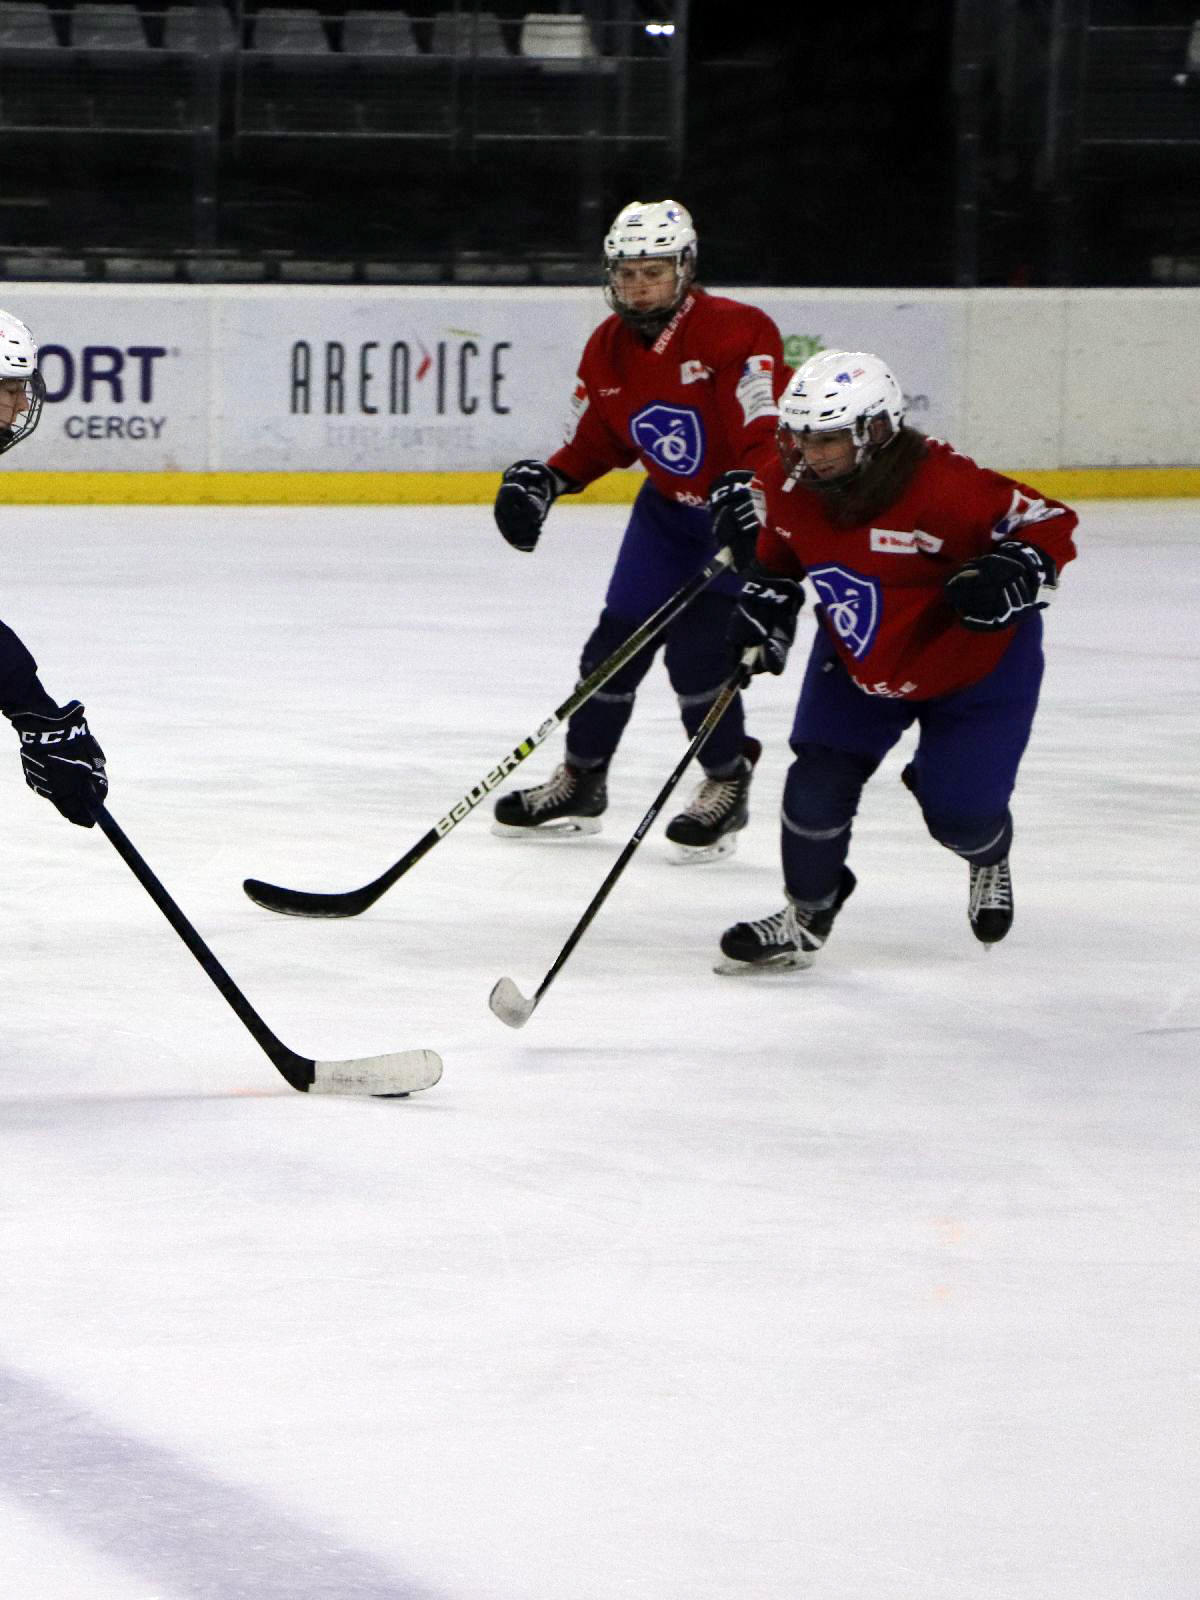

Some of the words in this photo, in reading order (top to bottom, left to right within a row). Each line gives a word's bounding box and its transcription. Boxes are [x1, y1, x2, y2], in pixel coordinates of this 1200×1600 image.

[63, 415, 167, 440] CERGY
[22, 722, 87, 745] CCM
[435, 754, 520, 839] BAUER
